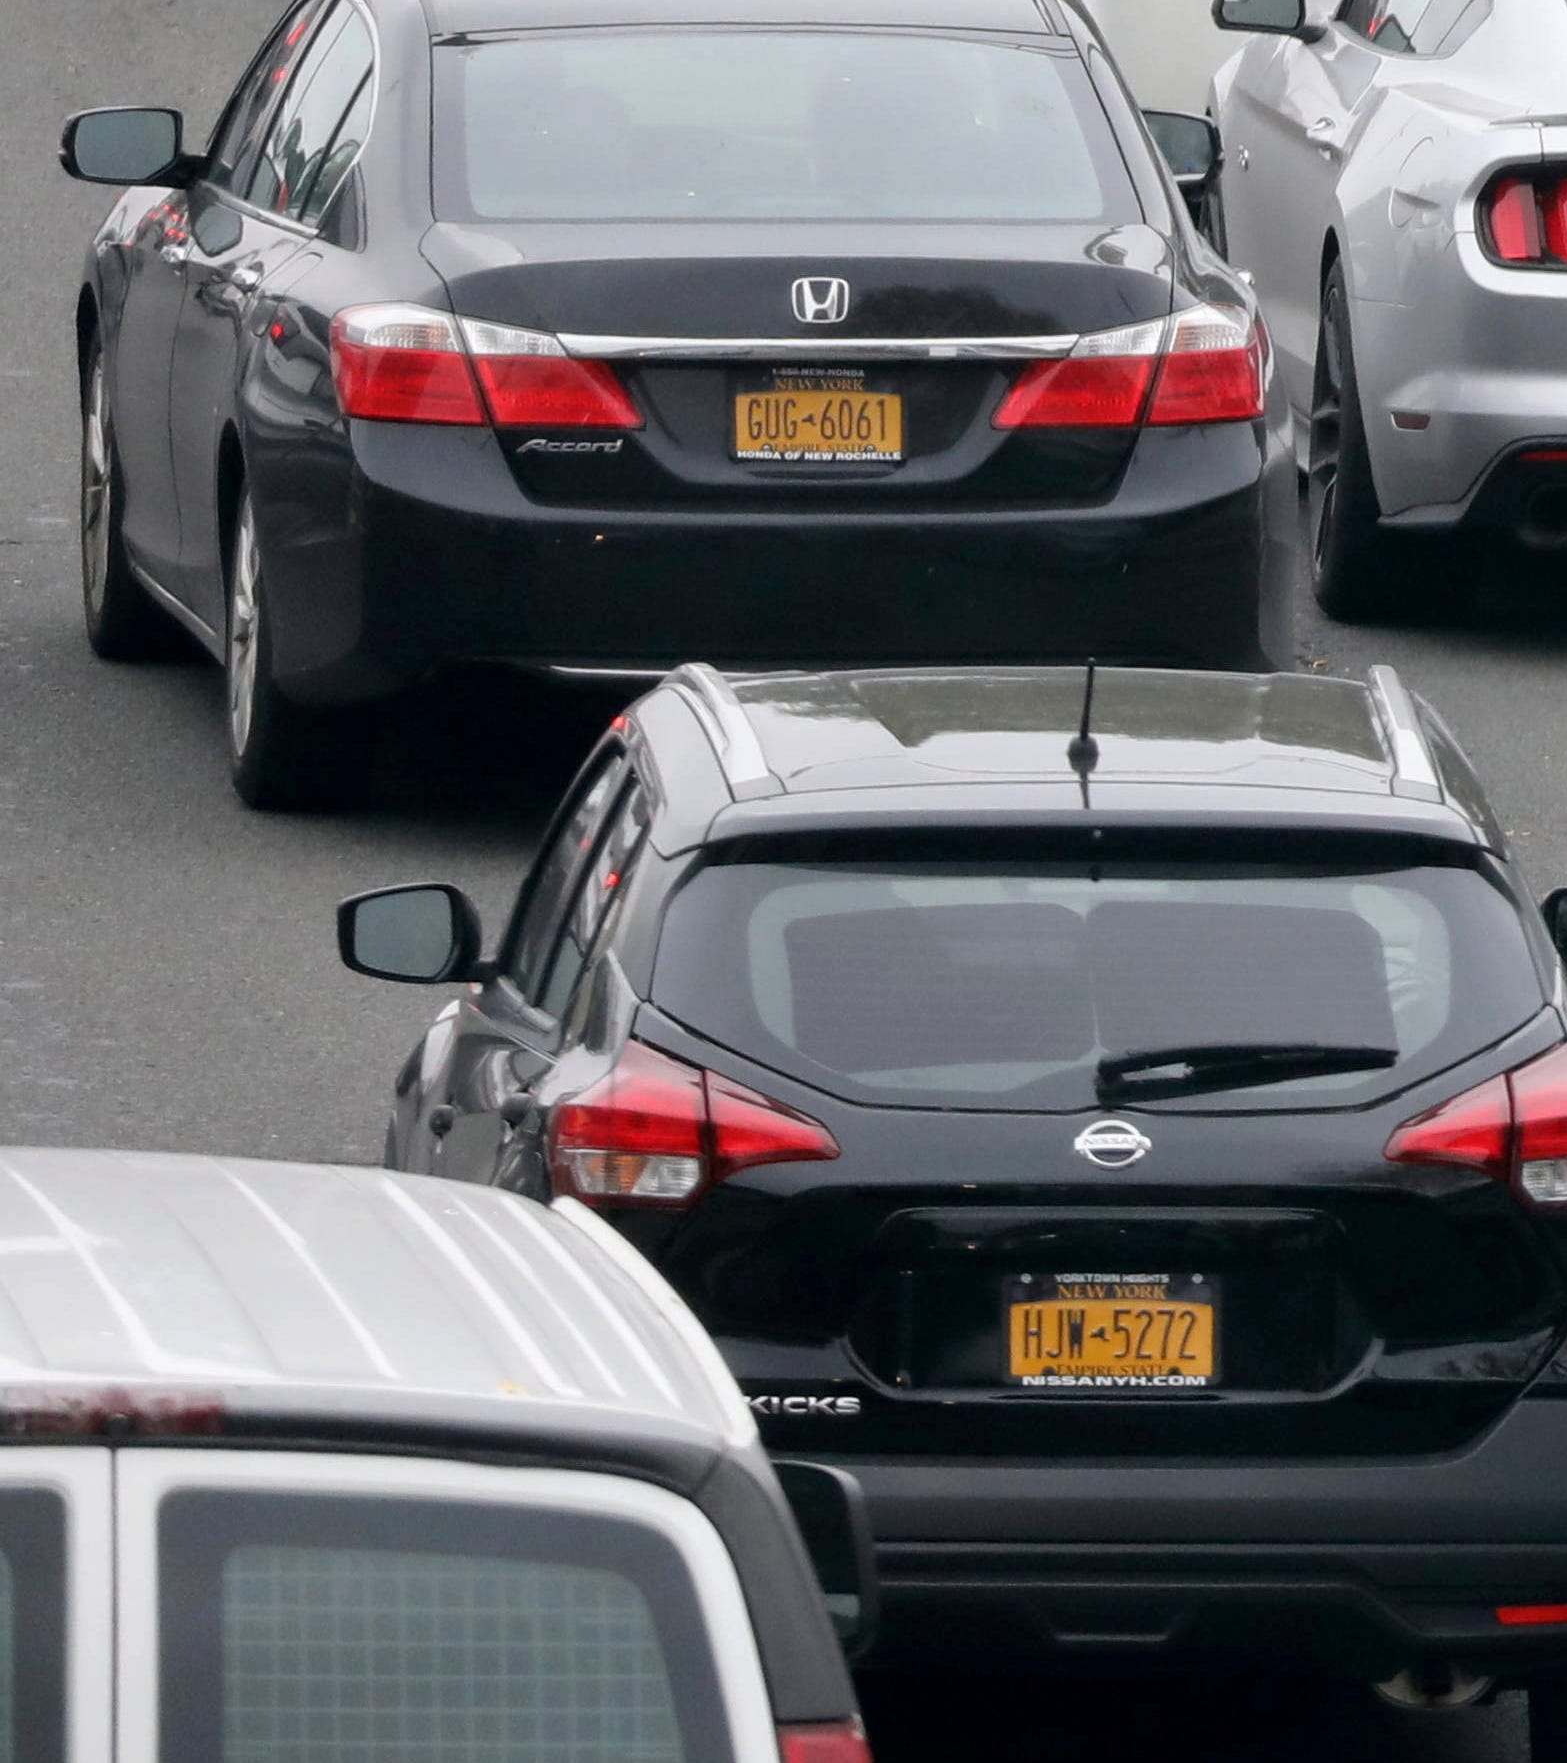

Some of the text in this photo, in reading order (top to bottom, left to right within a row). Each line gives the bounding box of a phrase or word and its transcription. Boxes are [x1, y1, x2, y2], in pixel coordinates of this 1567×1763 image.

[775, 377, 865, 391] NEW YORK
[516, 438, 624, 454] Accord
[736, 450, 902, 461] HONDA OF NEW ROCHELLE
[1054, 1273, 1170, 1284] YORKTOWN HEIGHTS
[1057, 1284, 1168, 1300] NEW YORK
[1022, 1375, 1207, 1387] NISSANYH.COM
[744, 1395, 861, 1415] KICKS
